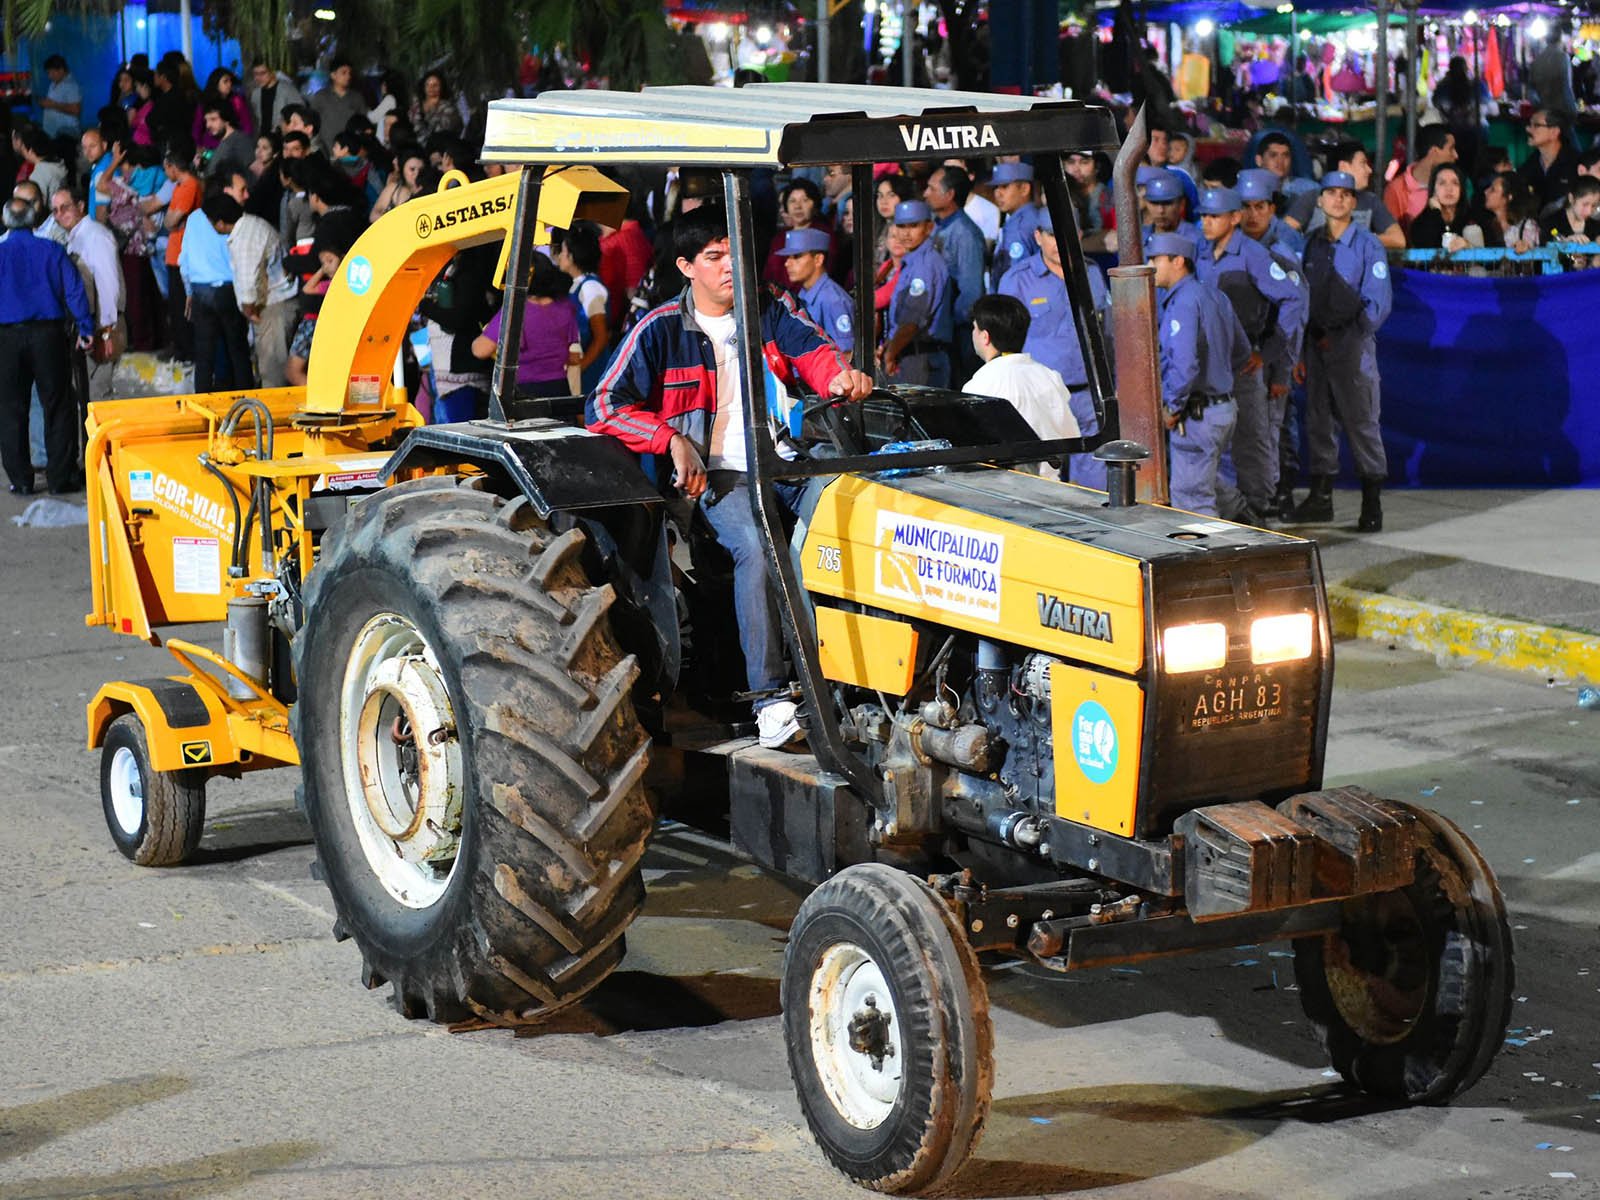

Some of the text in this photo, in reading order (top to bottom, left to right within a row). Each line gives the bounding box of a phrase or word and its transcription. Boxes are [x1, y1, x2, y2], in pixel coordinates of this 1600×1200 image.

[898, 123, 1000, 152] VALTRA
[154, 472, 226, 530] COR-VIAL
[816, 545, 842, 573] 785
[893, 523, 999, 564] MUNICIPALIDAD
[917, 555, 997, 594] DE FORMOSA
[1036, 591, 1114, 644] VALTRA
[1194, 683, 1281, 716] AGH 83
